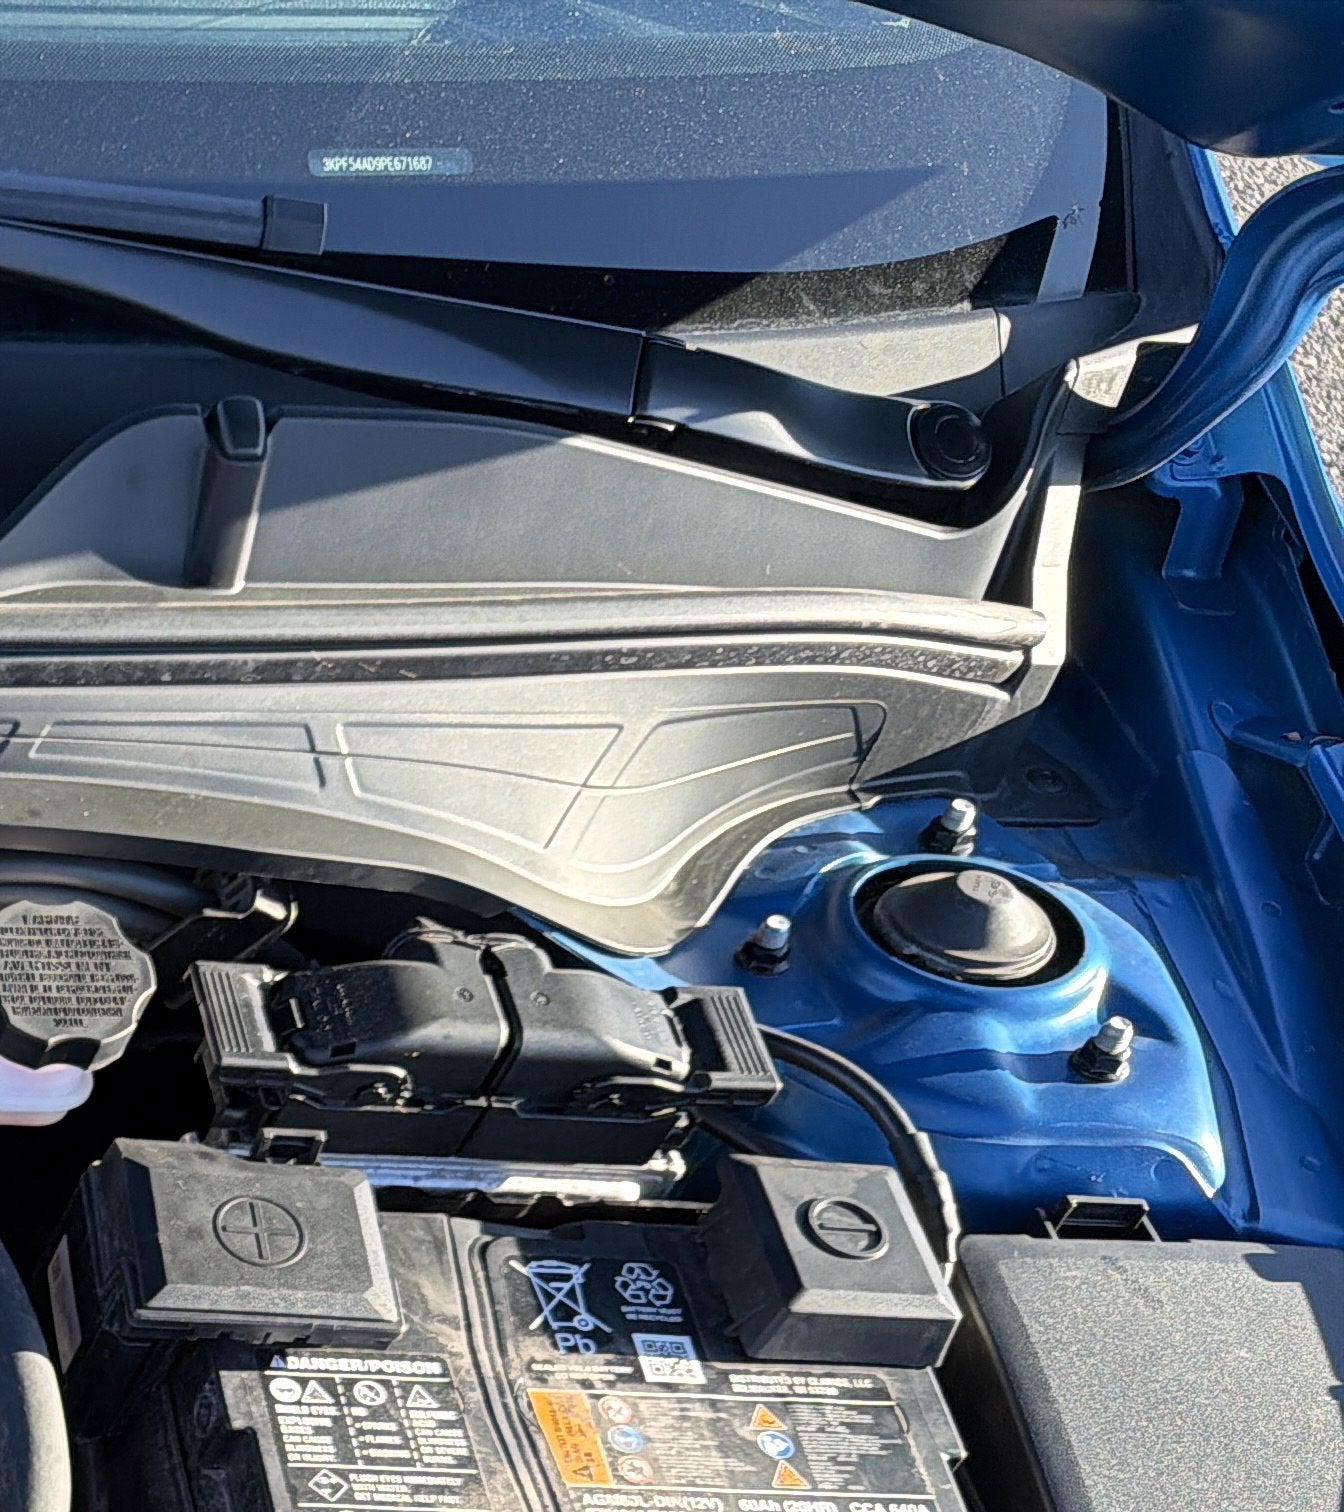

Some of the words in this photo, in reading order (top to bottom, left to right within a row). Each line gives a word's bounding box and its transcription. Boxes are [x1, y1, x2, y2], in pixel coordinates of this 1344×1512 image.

[555, 1333, 598, 1354] Pb
[286, 1356, 444, 1375] DANGER/POISON
[738, 1499, 781, 1512] 60Ah
